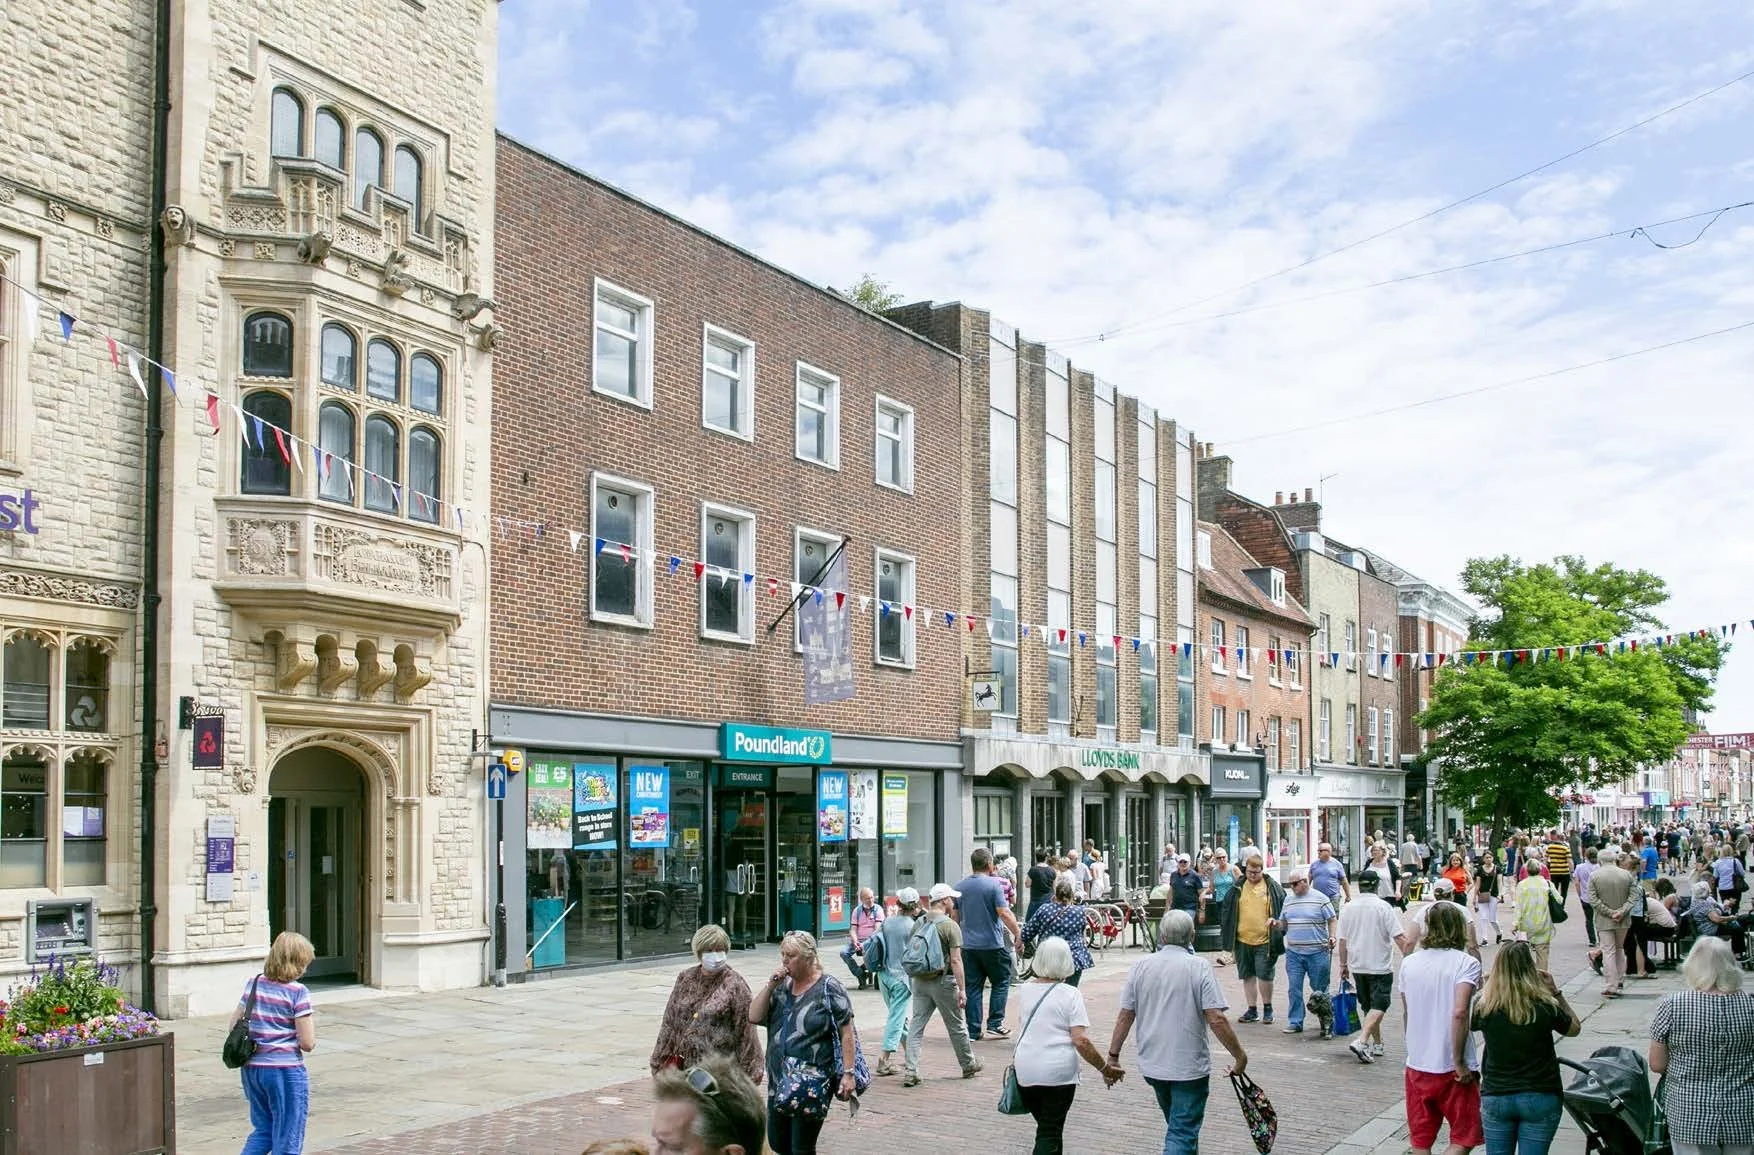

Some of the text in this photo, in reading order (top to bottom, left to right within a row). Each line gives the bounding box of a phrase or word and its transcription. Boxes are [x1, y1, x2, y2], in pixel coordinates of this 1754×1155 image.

[735, 731, 808, 756] Poundland
[1714, 735, 1746, 748] FILM
[1081, 749, 1140, 769] LLOYDS BANK
[553, 766, 567, 780] £5
[686, 770, 699, 779] EXIT
[732, 772, 763, 781] ENTRANCE
[635, 771, 663, 792] NEW
[823, 776, 844, 793] NEW
[577, 814, 590, 824] Back
